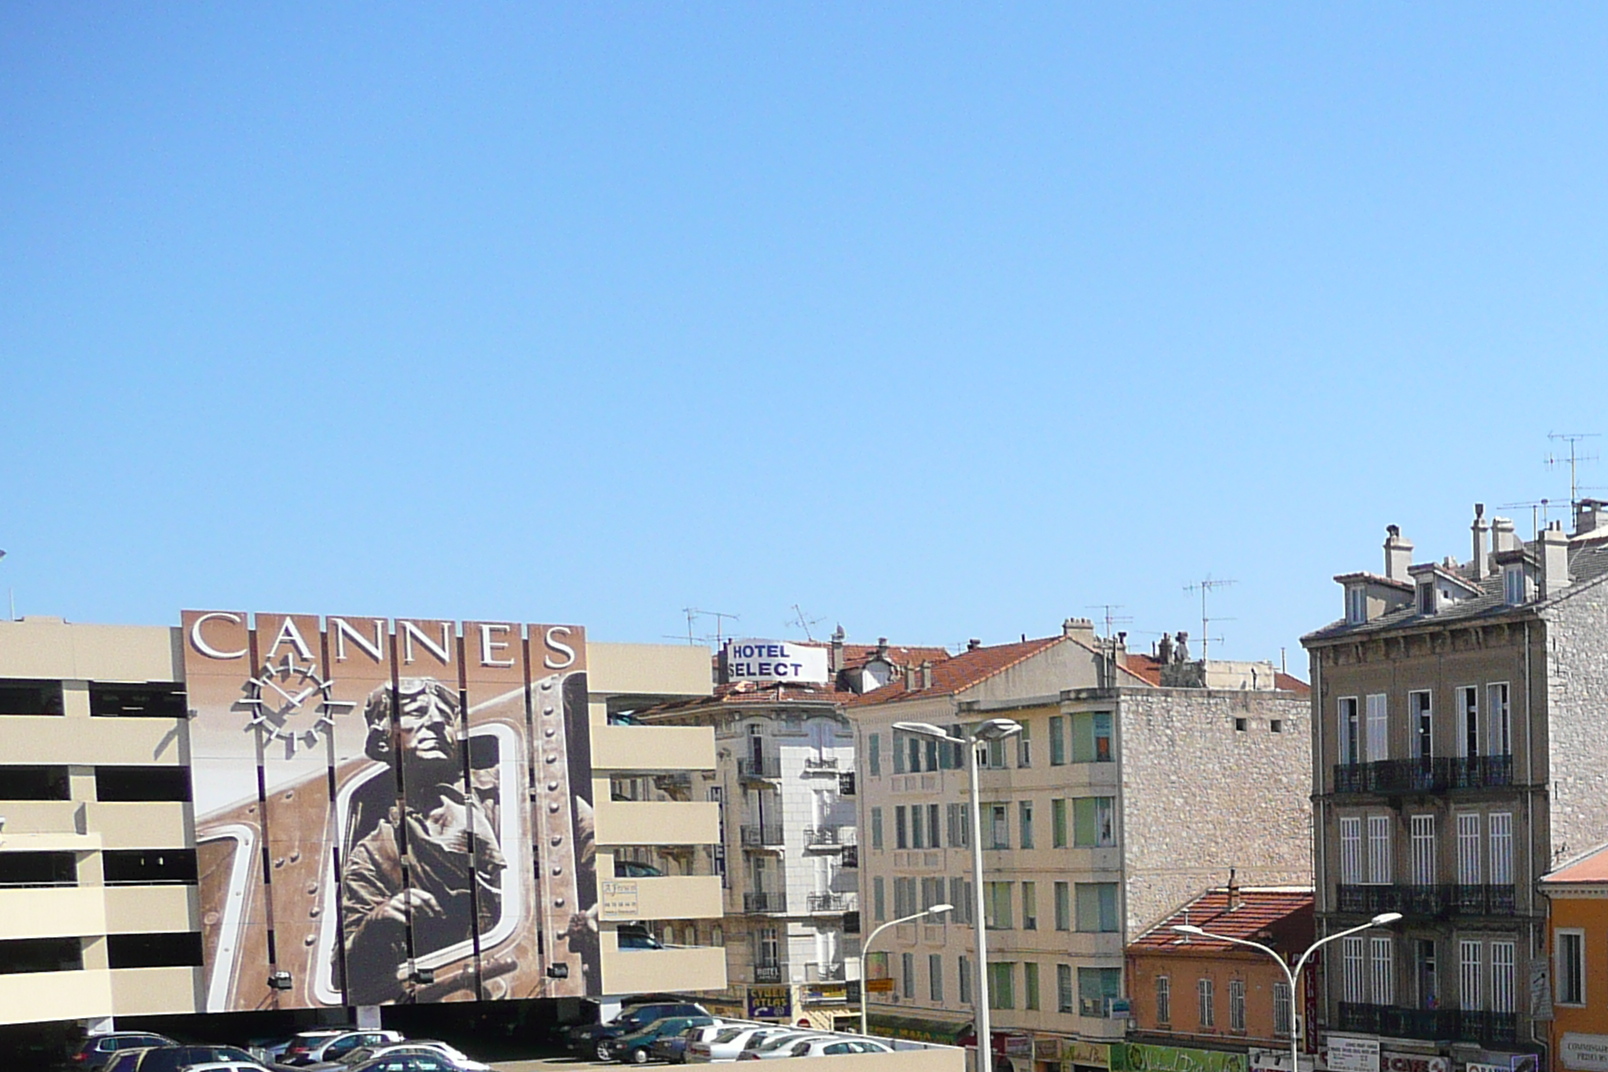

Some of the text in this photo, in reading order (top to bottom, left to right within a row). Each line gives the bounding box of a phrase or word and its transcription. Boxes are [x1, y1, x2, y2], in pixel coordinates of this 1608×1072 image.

[190, 611, 576, 669] CANNES
[733, 644, 790, 659] HOTEL
[728, 662, 803, 677] SELECT
[752, 998, 788, 1007] ATLAS
